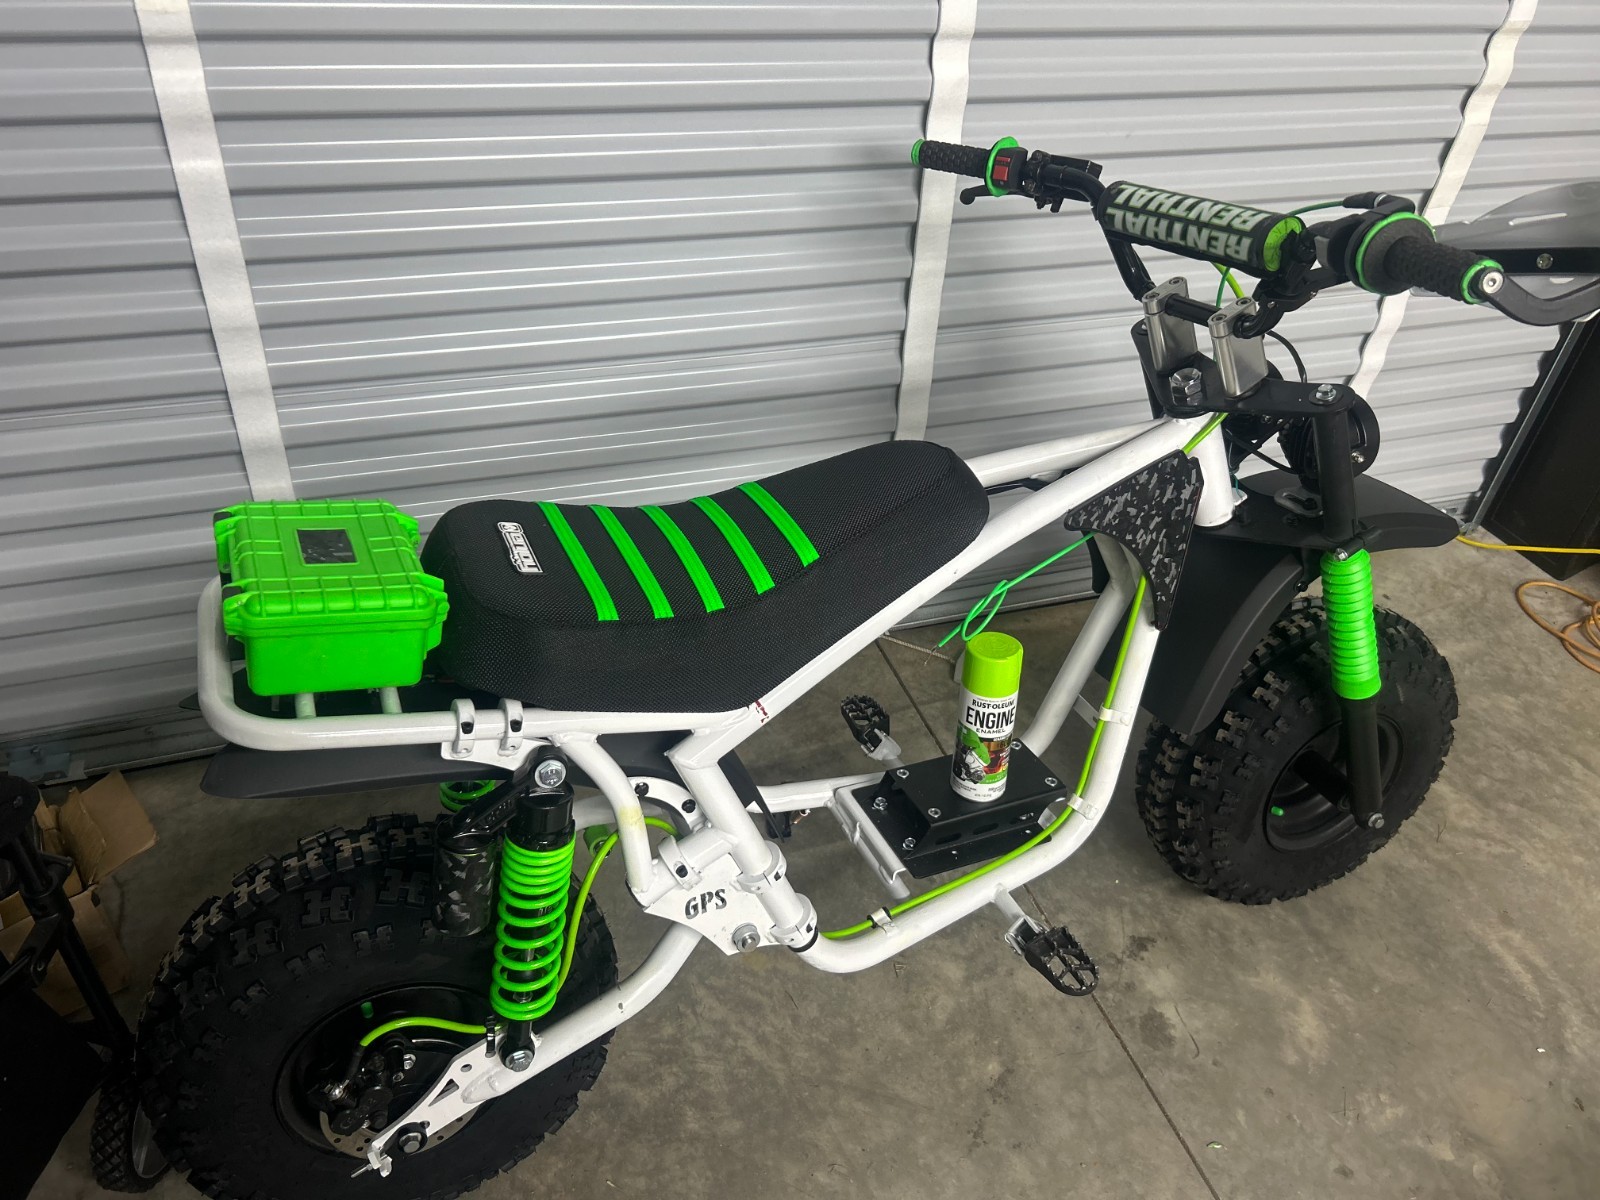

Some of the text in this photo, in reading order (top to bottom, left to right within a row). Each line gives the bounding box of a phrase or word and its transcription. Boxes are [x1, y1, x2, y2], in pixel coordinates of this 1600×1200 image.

[1113, 184, 1271, 231] RENTHAL
[1106, 207, 1254, 261] RENTHAL
[966, 706, 1015, 729] ENGINE
[685, 888, 728, 920] GPS
